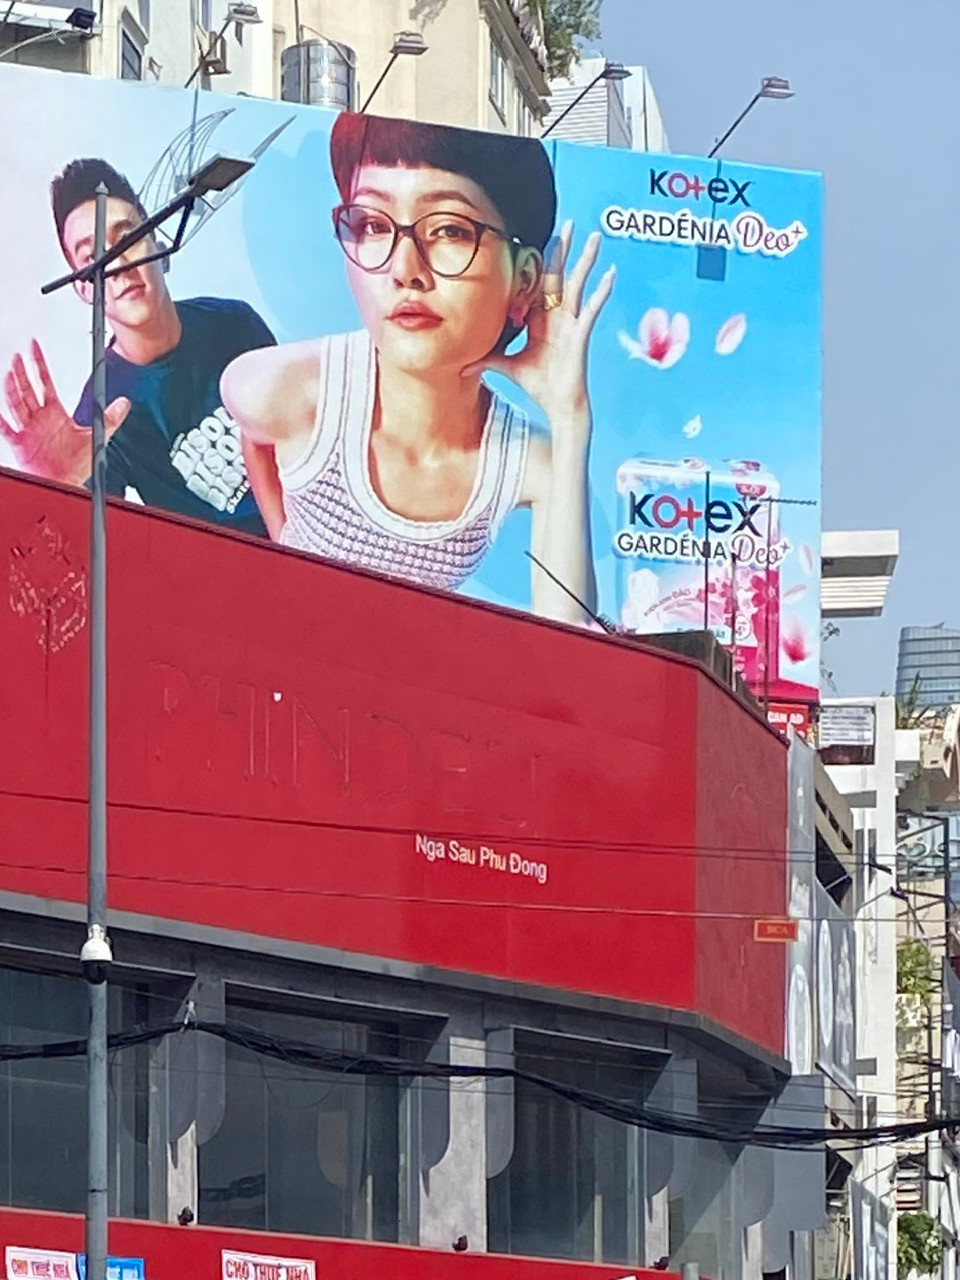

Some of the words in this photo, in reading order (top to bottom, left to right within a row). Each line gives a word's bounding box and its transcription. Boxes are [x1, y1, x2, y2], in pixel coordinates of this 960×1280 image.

[606, 210, 730, 245] GARDÉNIA
[415, 833, 445, 862] Nga
[448, 840, 476, 865] Sau
[480, 847, 506, 872] Phu
[509, 853, 547, 884] Đong
[226, 1259, 249, 1280] CHO
